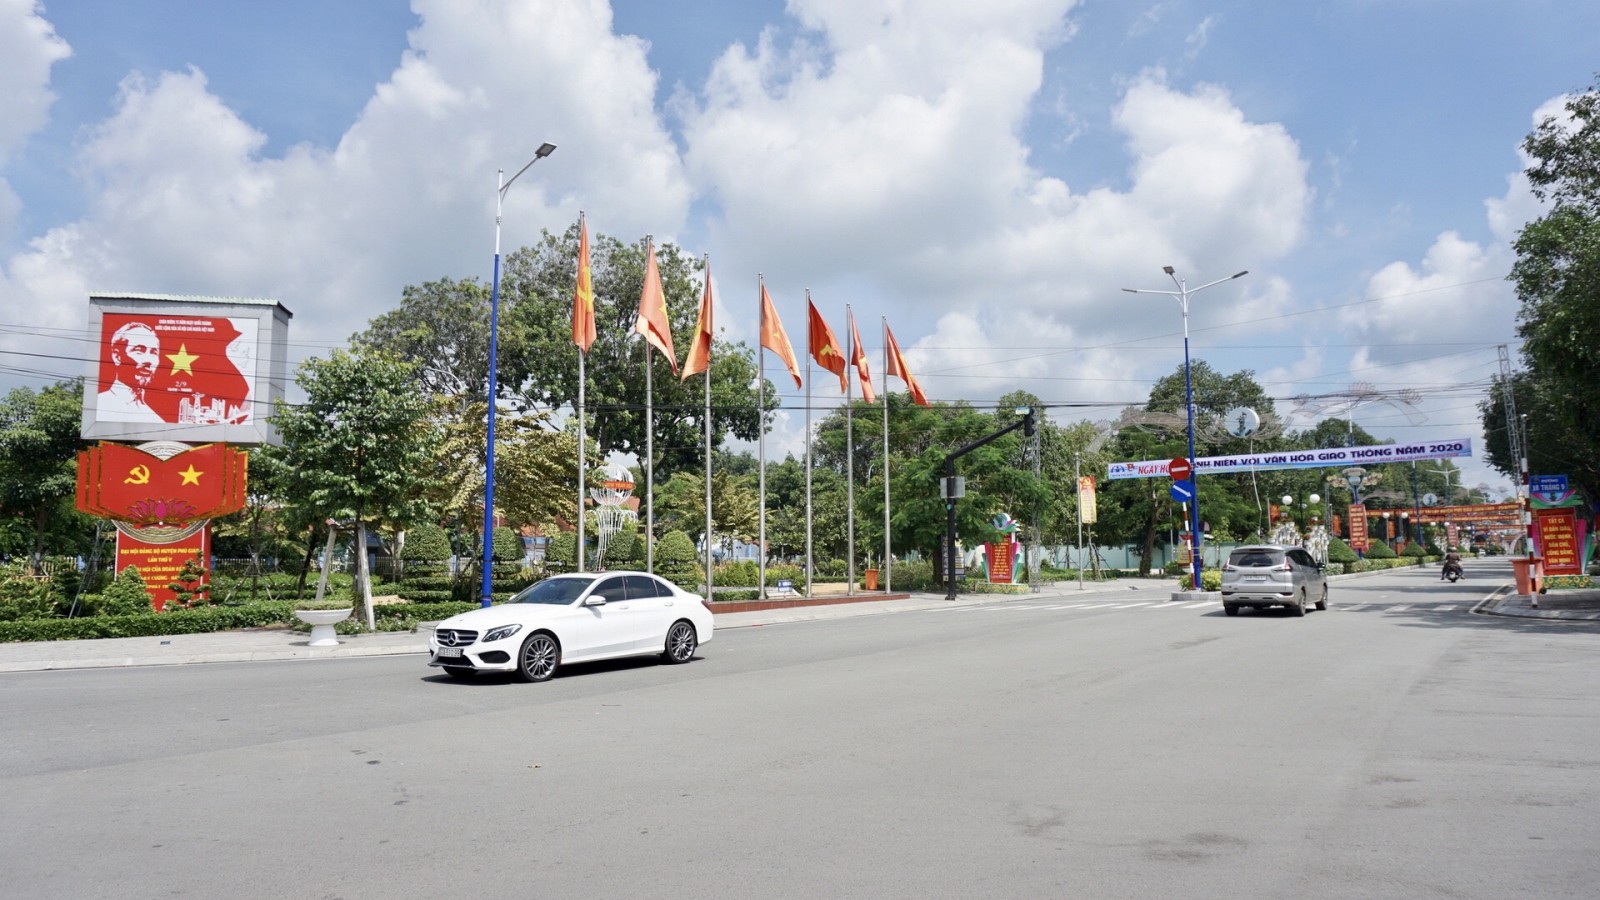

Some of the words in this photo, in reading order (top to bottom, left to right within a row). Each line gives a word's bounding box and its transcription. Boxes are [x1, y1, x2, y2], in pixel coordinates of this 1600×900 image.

[1138, 464, 1157, 475] NGÀY
[1213, 458, 1237, 468] NIÊN
[1318, 452, 1346, 462] GIAO
[1350, 446, 1392, 459] THÔNG
[1396, 444, 1425, 457] NĂM
[1430, 442, 1463, 454] 2020
[1541, 482, 1560, 490] THÁNG
